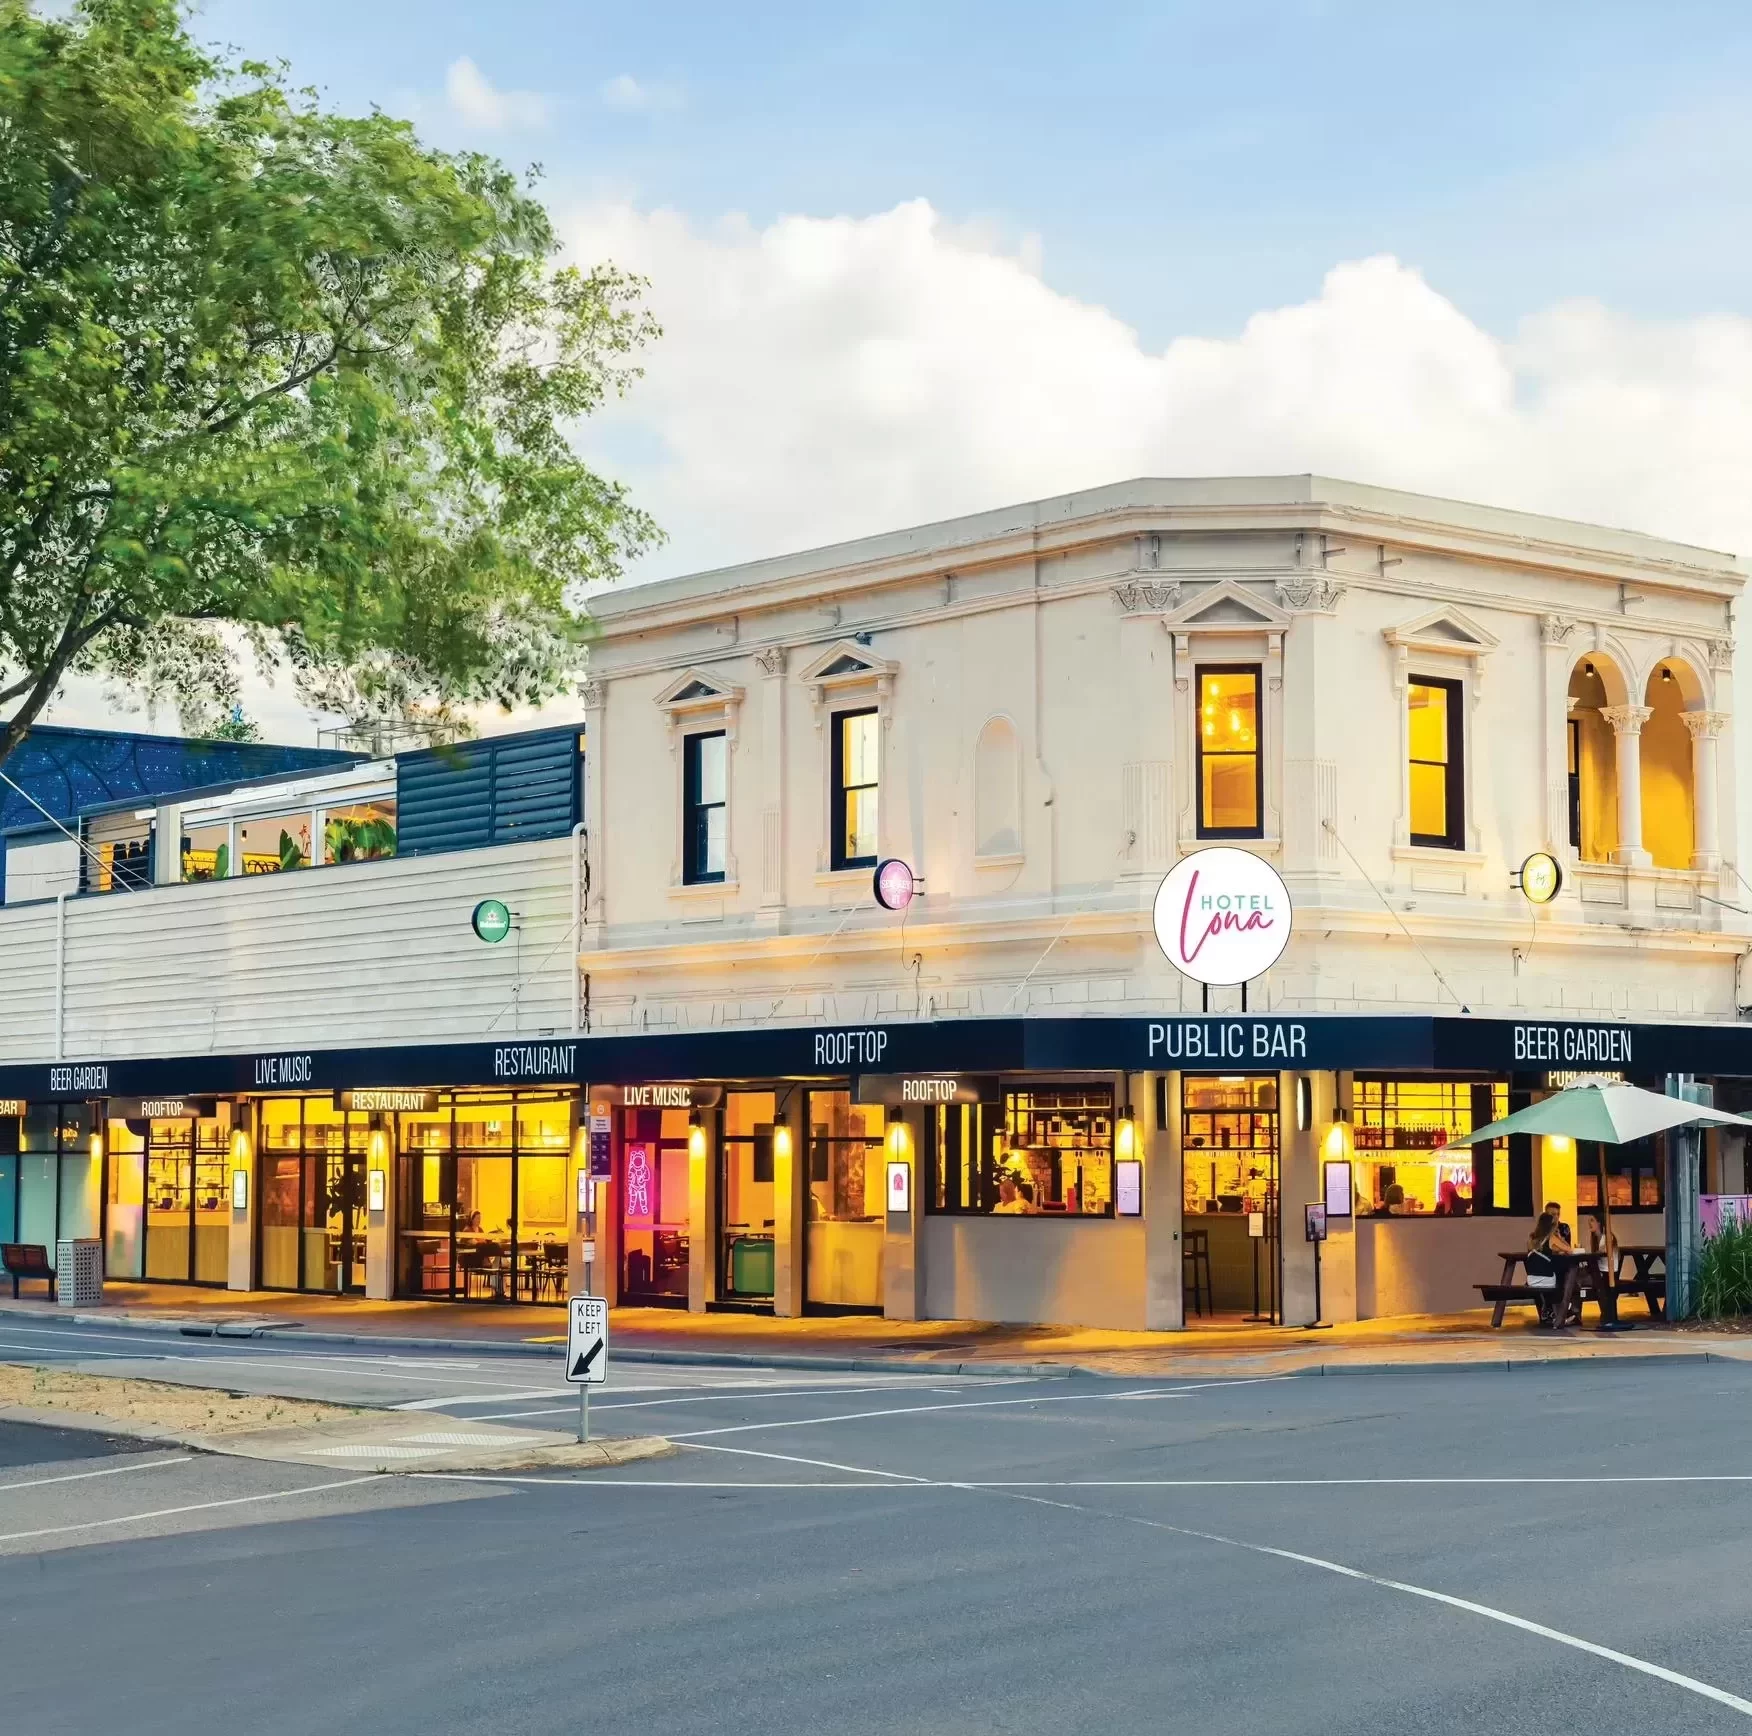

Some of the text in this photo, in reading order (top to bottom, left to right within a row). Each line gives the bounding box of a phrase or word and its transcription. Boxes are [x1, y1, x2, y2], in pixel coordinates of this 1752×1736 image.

[1201, 895, 1274, 910] HOTEL
[1180, 870, 1274, 964] Lona
[815, 1030, 887, 1065] ROOFTOP
[1149, 1024, 1306, 1057] PUBLIC BAR
[1514, 1026, 1632, 1062] BEER GARDEN
[255, 1055, 312, 1084] LIVE MUSIC
[495, 1045, 577, 1076] RESTAURANT
[50, 1066, 108, 1091] BEER GARDEN
[352, 1092, 426, 1110] RESTAURANT
[623, 1087, 692, 1106] LIVE MUSIC
[903, 1080, 957, 1101] ROOFTOP
[141, 1101, 184, 1117] ROOFTOP
[577, 1304, 602, 1317] KEEP
[578, 1321, 601, 1335] LEFT
